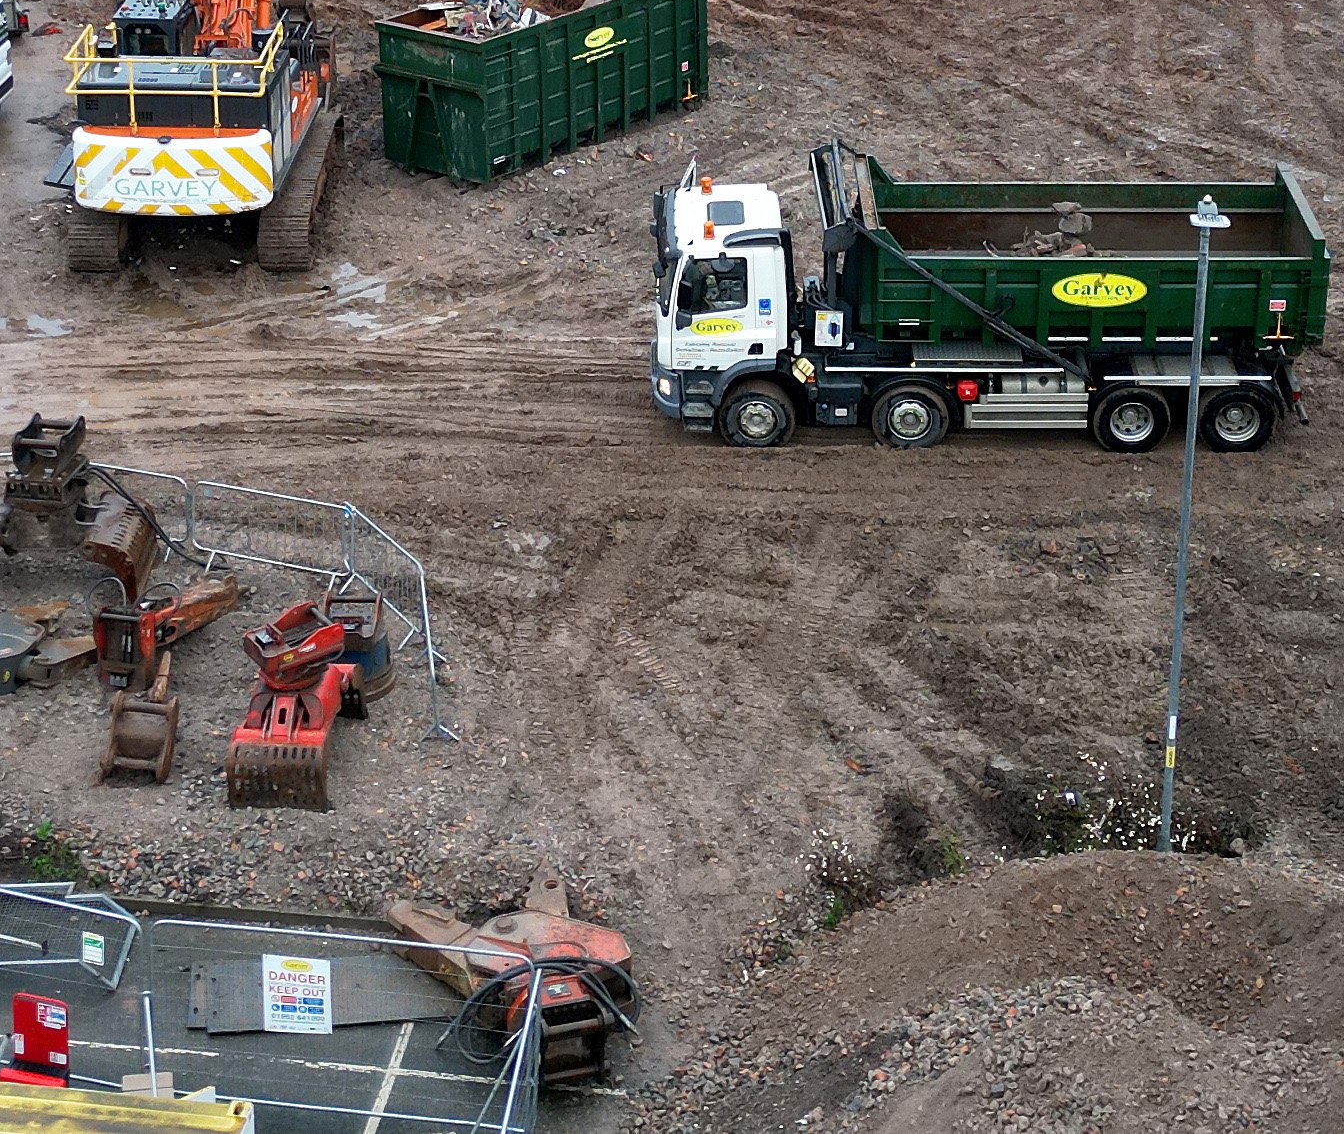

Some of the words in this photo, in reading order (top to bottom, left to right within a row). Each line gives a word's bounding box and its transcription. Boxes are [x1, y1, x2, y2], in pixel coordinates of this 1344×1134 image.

[115, 178, 218, 197] GARVEY
[1062, 280, 1136, 301] Garvey
[696, 321, 738, 333] Garvey
[268, 971, 326, 984] DANGER
[268, 985, 299, 995] KEEP
[302, 988, 326, 997] OUT
